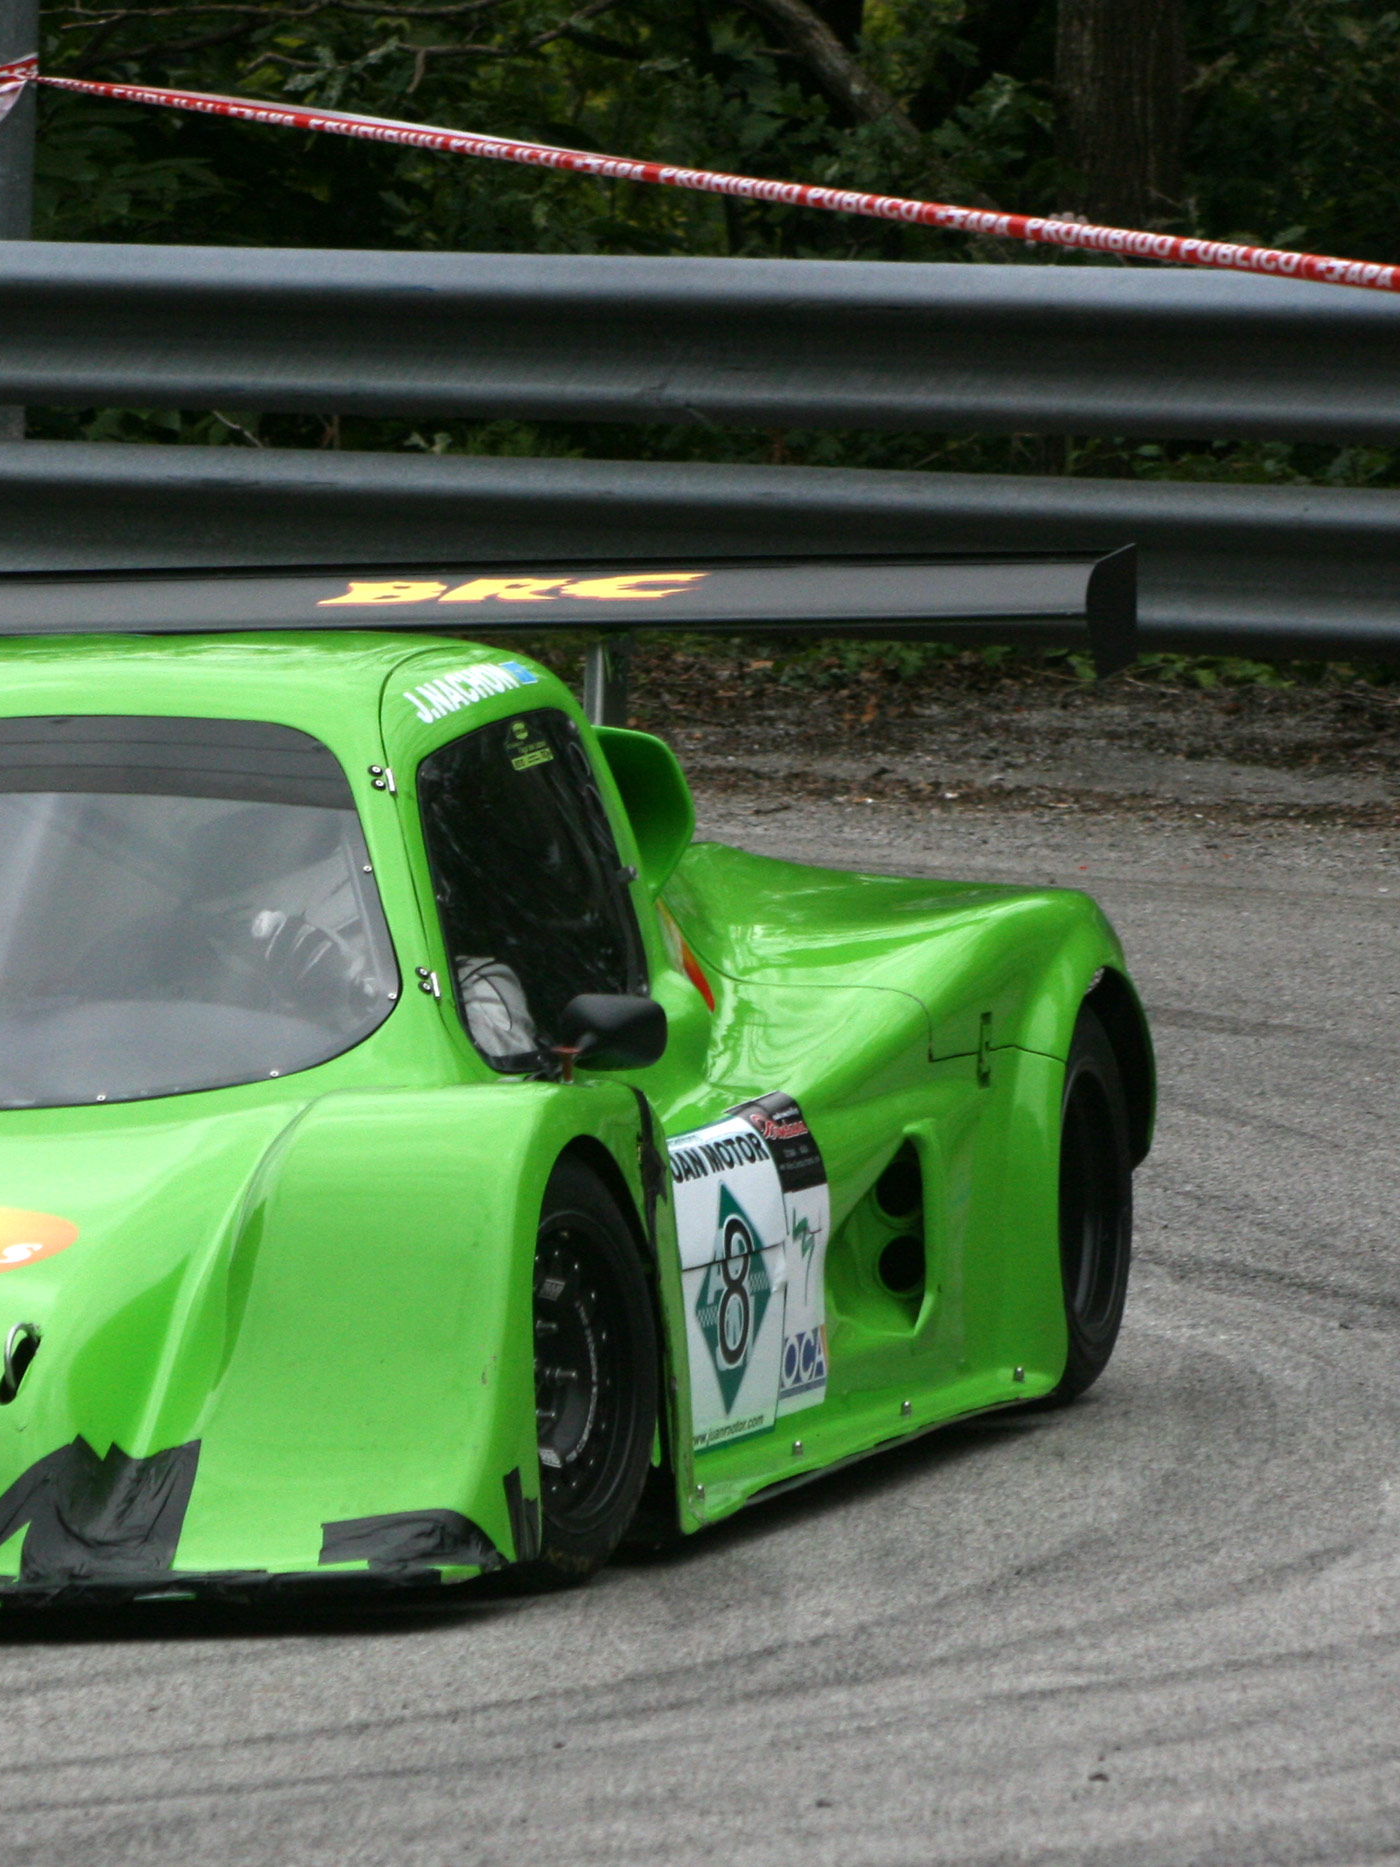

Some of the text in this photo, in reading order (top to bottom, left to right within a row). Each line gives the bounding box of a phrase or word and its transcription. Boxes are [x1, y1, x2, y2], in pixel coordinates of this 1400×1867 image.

[1024, 217, 1175, 257] PROHIBIDO
[317, 572, 711, 607] BRC
[670, 1149, 708, 1184] UAN
[699, 1133, 770, 1173] MOTOR
[719, 1214, 754, 1369] 8
